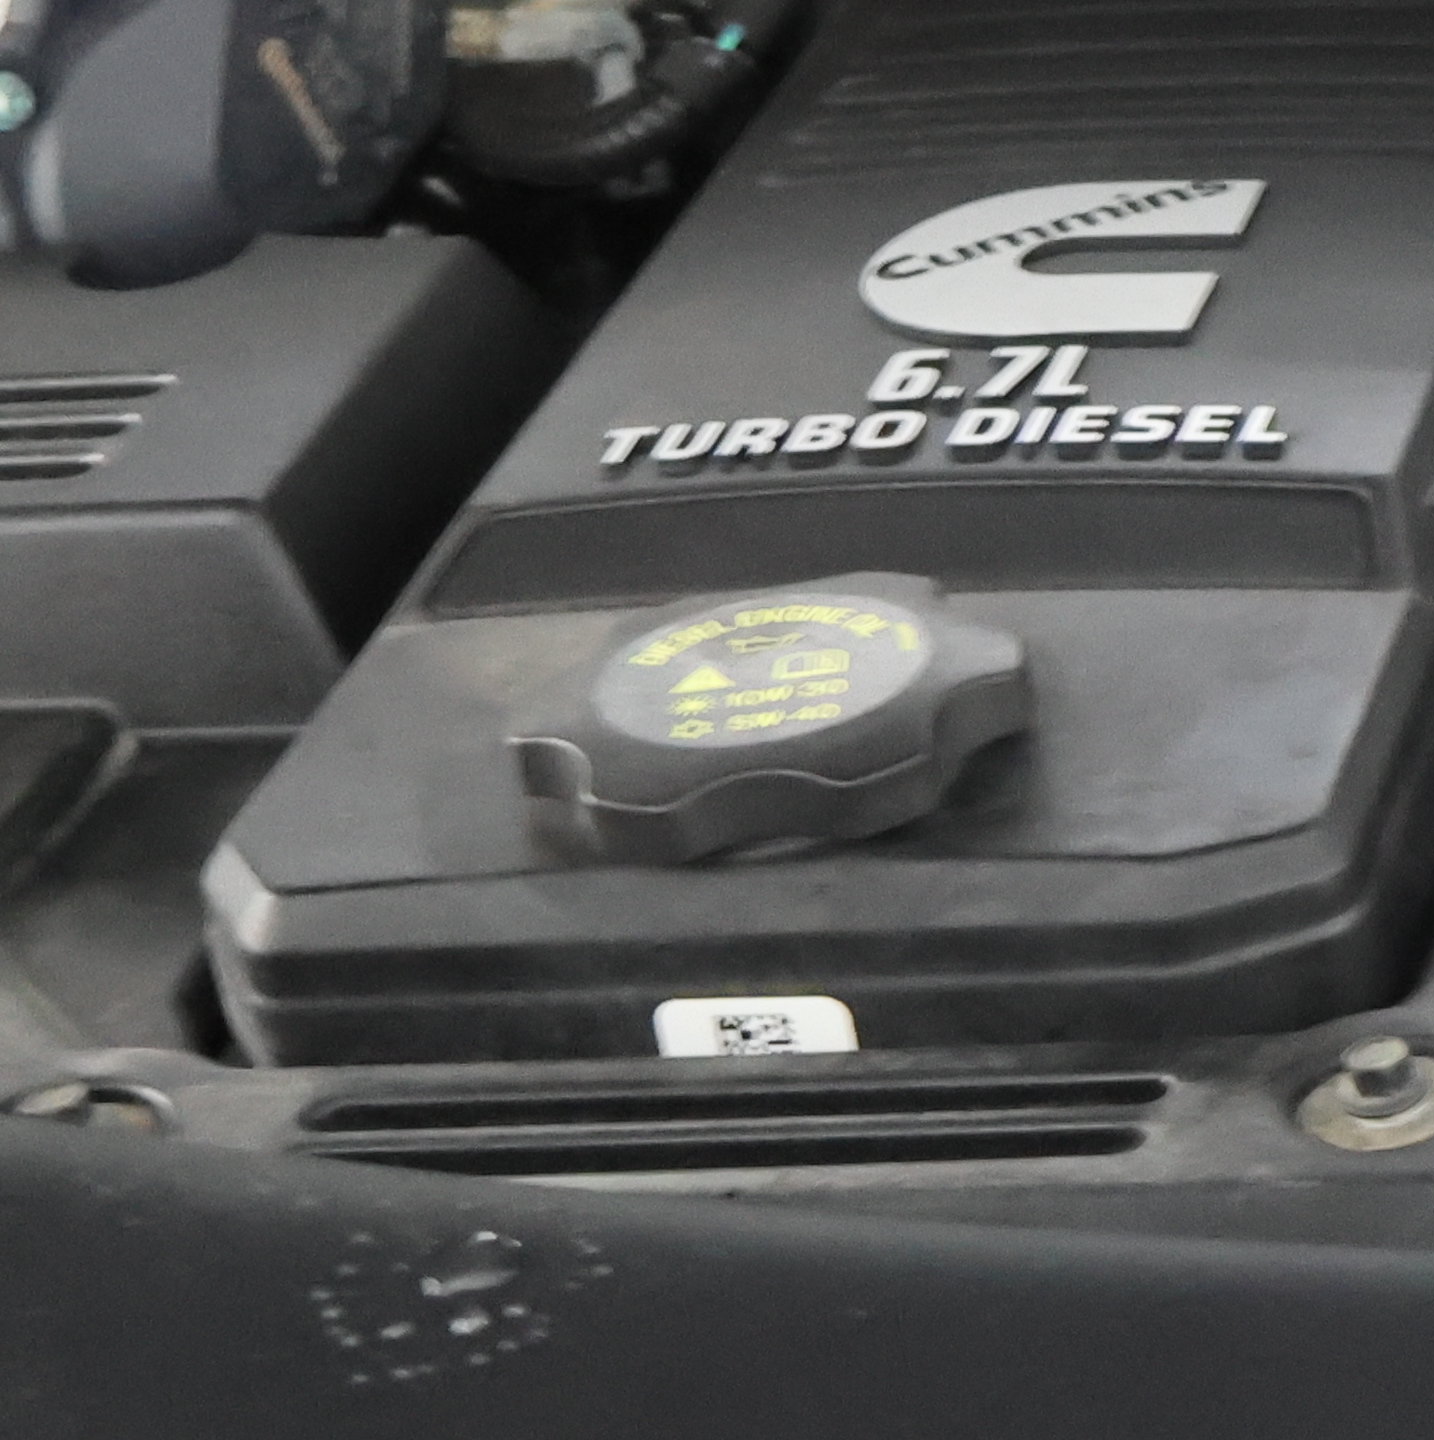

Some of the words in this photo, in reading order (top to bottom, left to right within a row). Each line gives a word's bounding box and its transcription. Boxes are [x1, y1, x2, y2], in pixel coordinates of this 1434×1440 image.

[876, 177, 1228, 280] Cummins
[867, 345, 1089, 403] 6.7L
[601, 408, 928, 464] TURBO
[945, 405, 1288, 446] DIESEL
